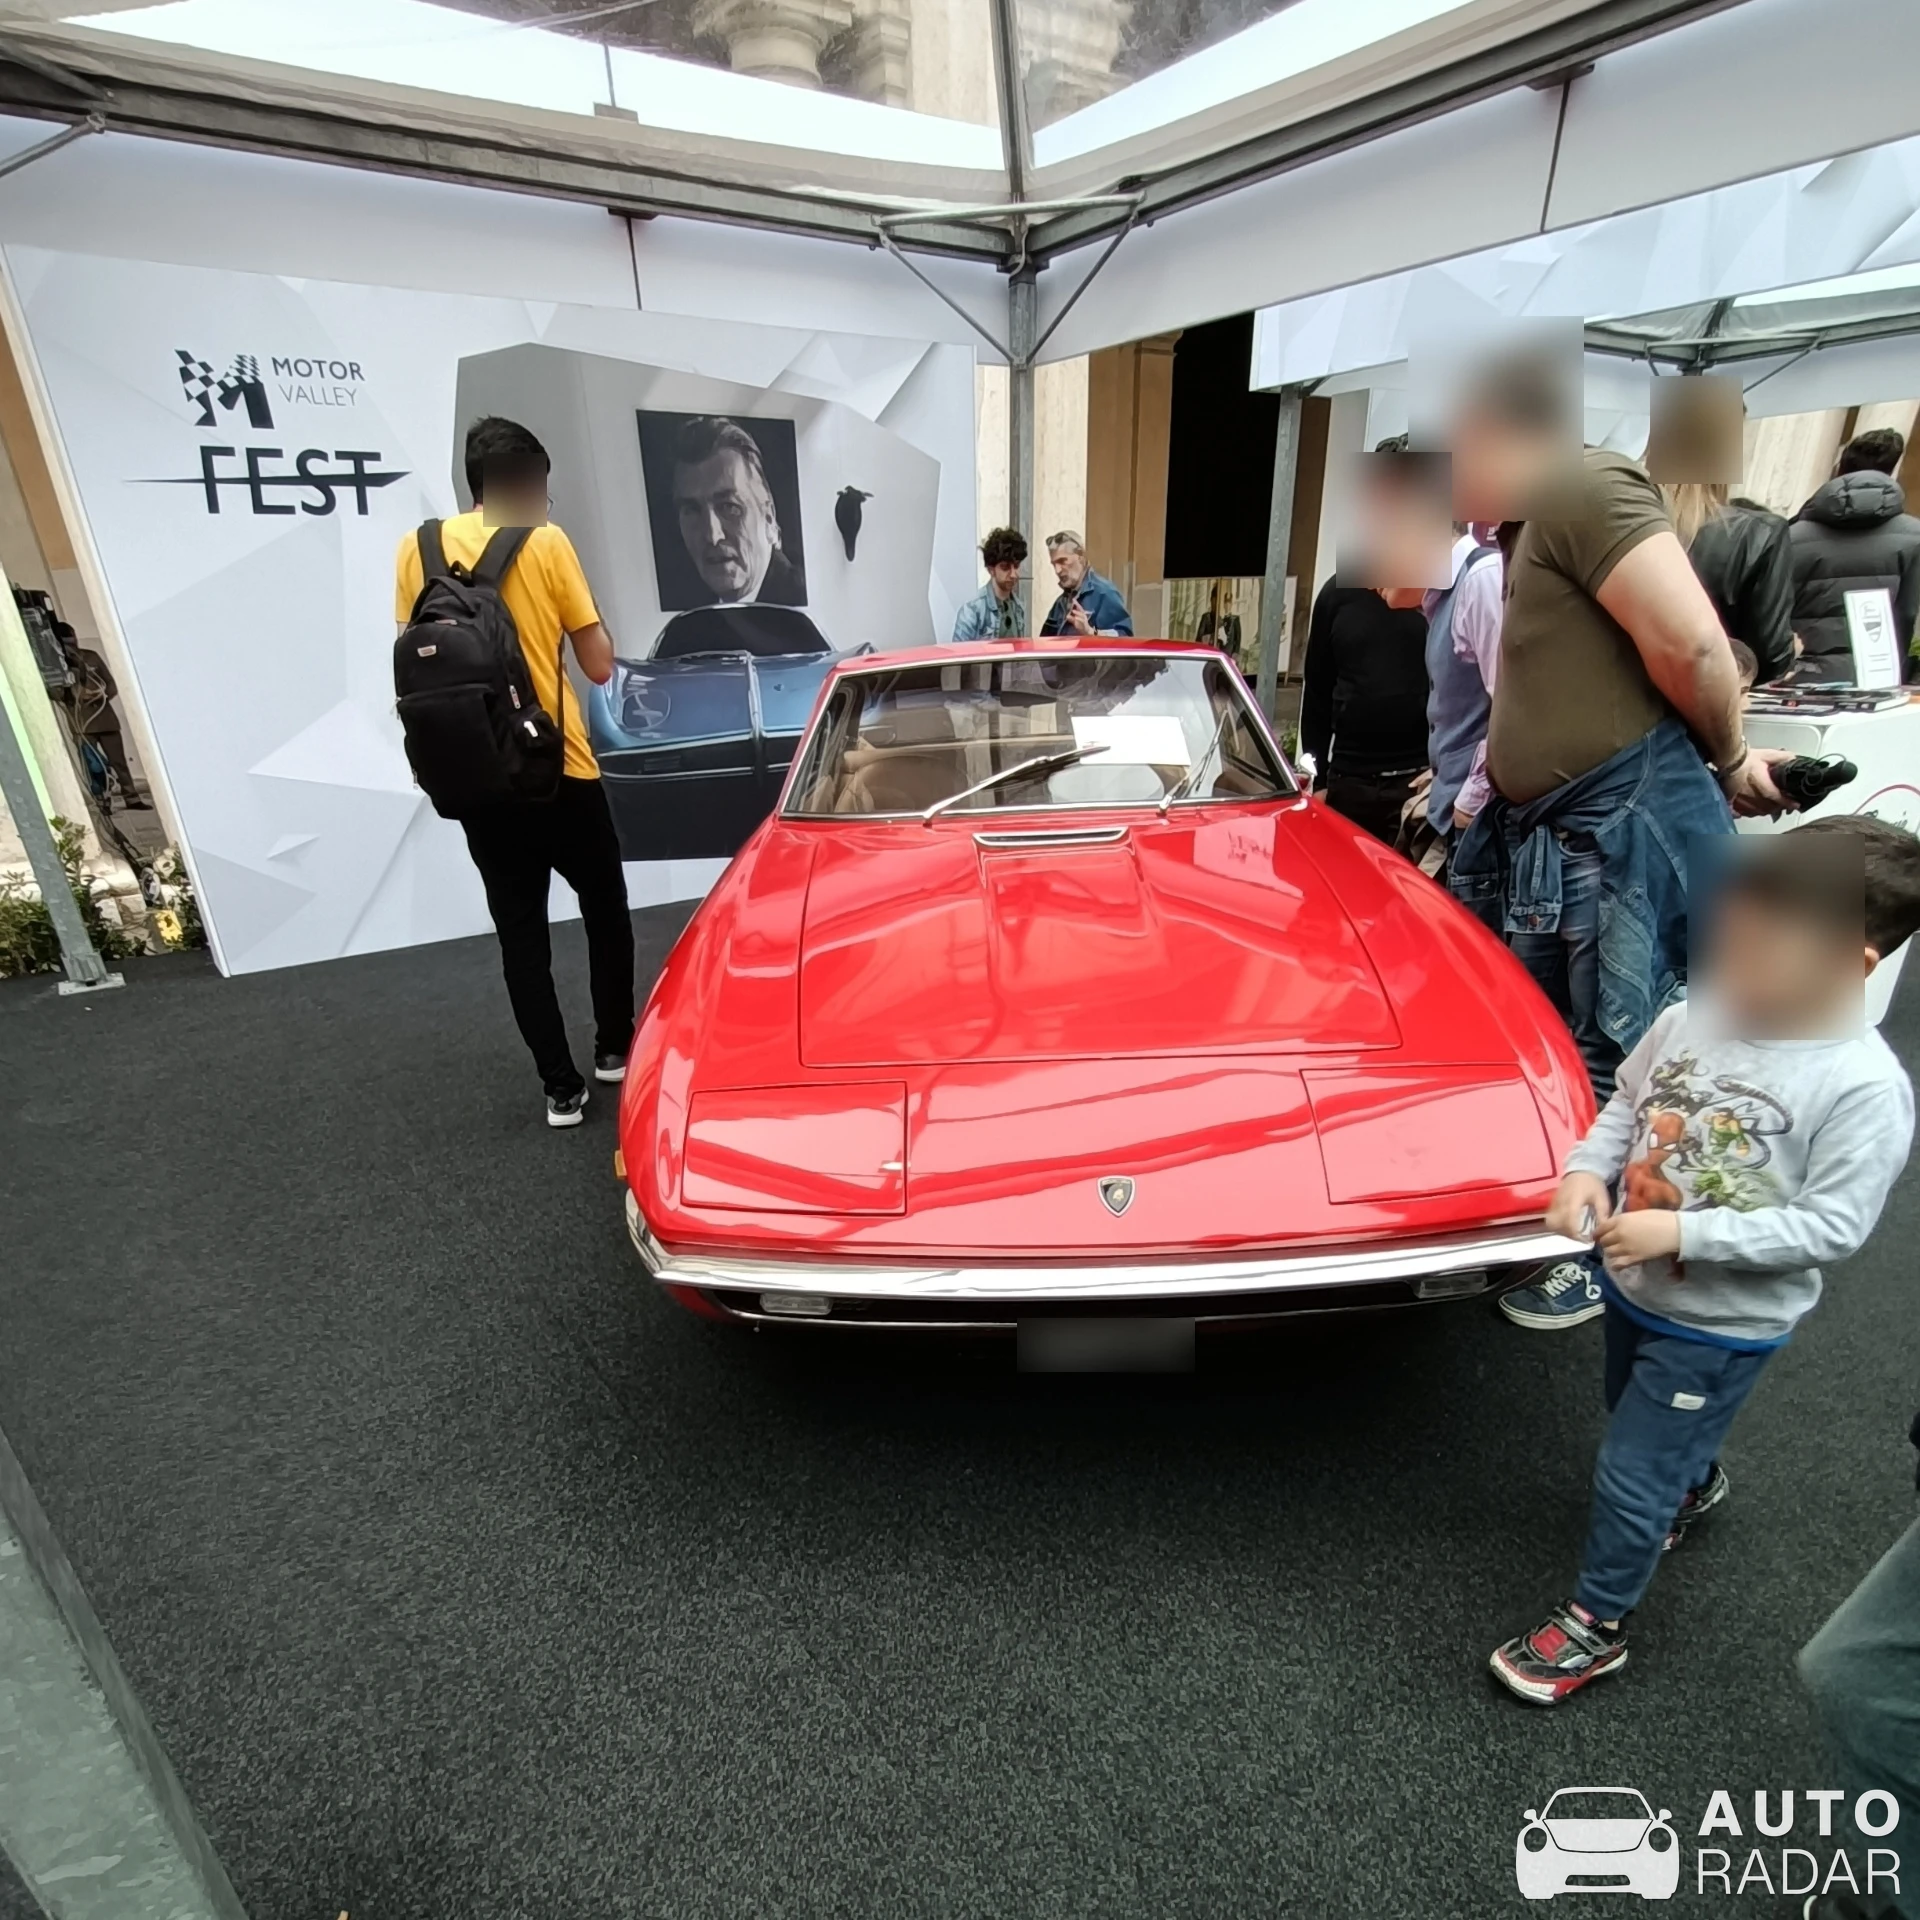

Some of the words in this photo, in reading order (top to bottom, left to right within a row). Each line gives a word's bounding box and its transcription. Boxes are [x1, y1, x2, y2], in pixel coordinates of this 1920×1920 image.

[271, 356, 366, 382] MOTOR
[278, 384, 358, 407] VALLEY
[199, 445, 382, 516] FEST
